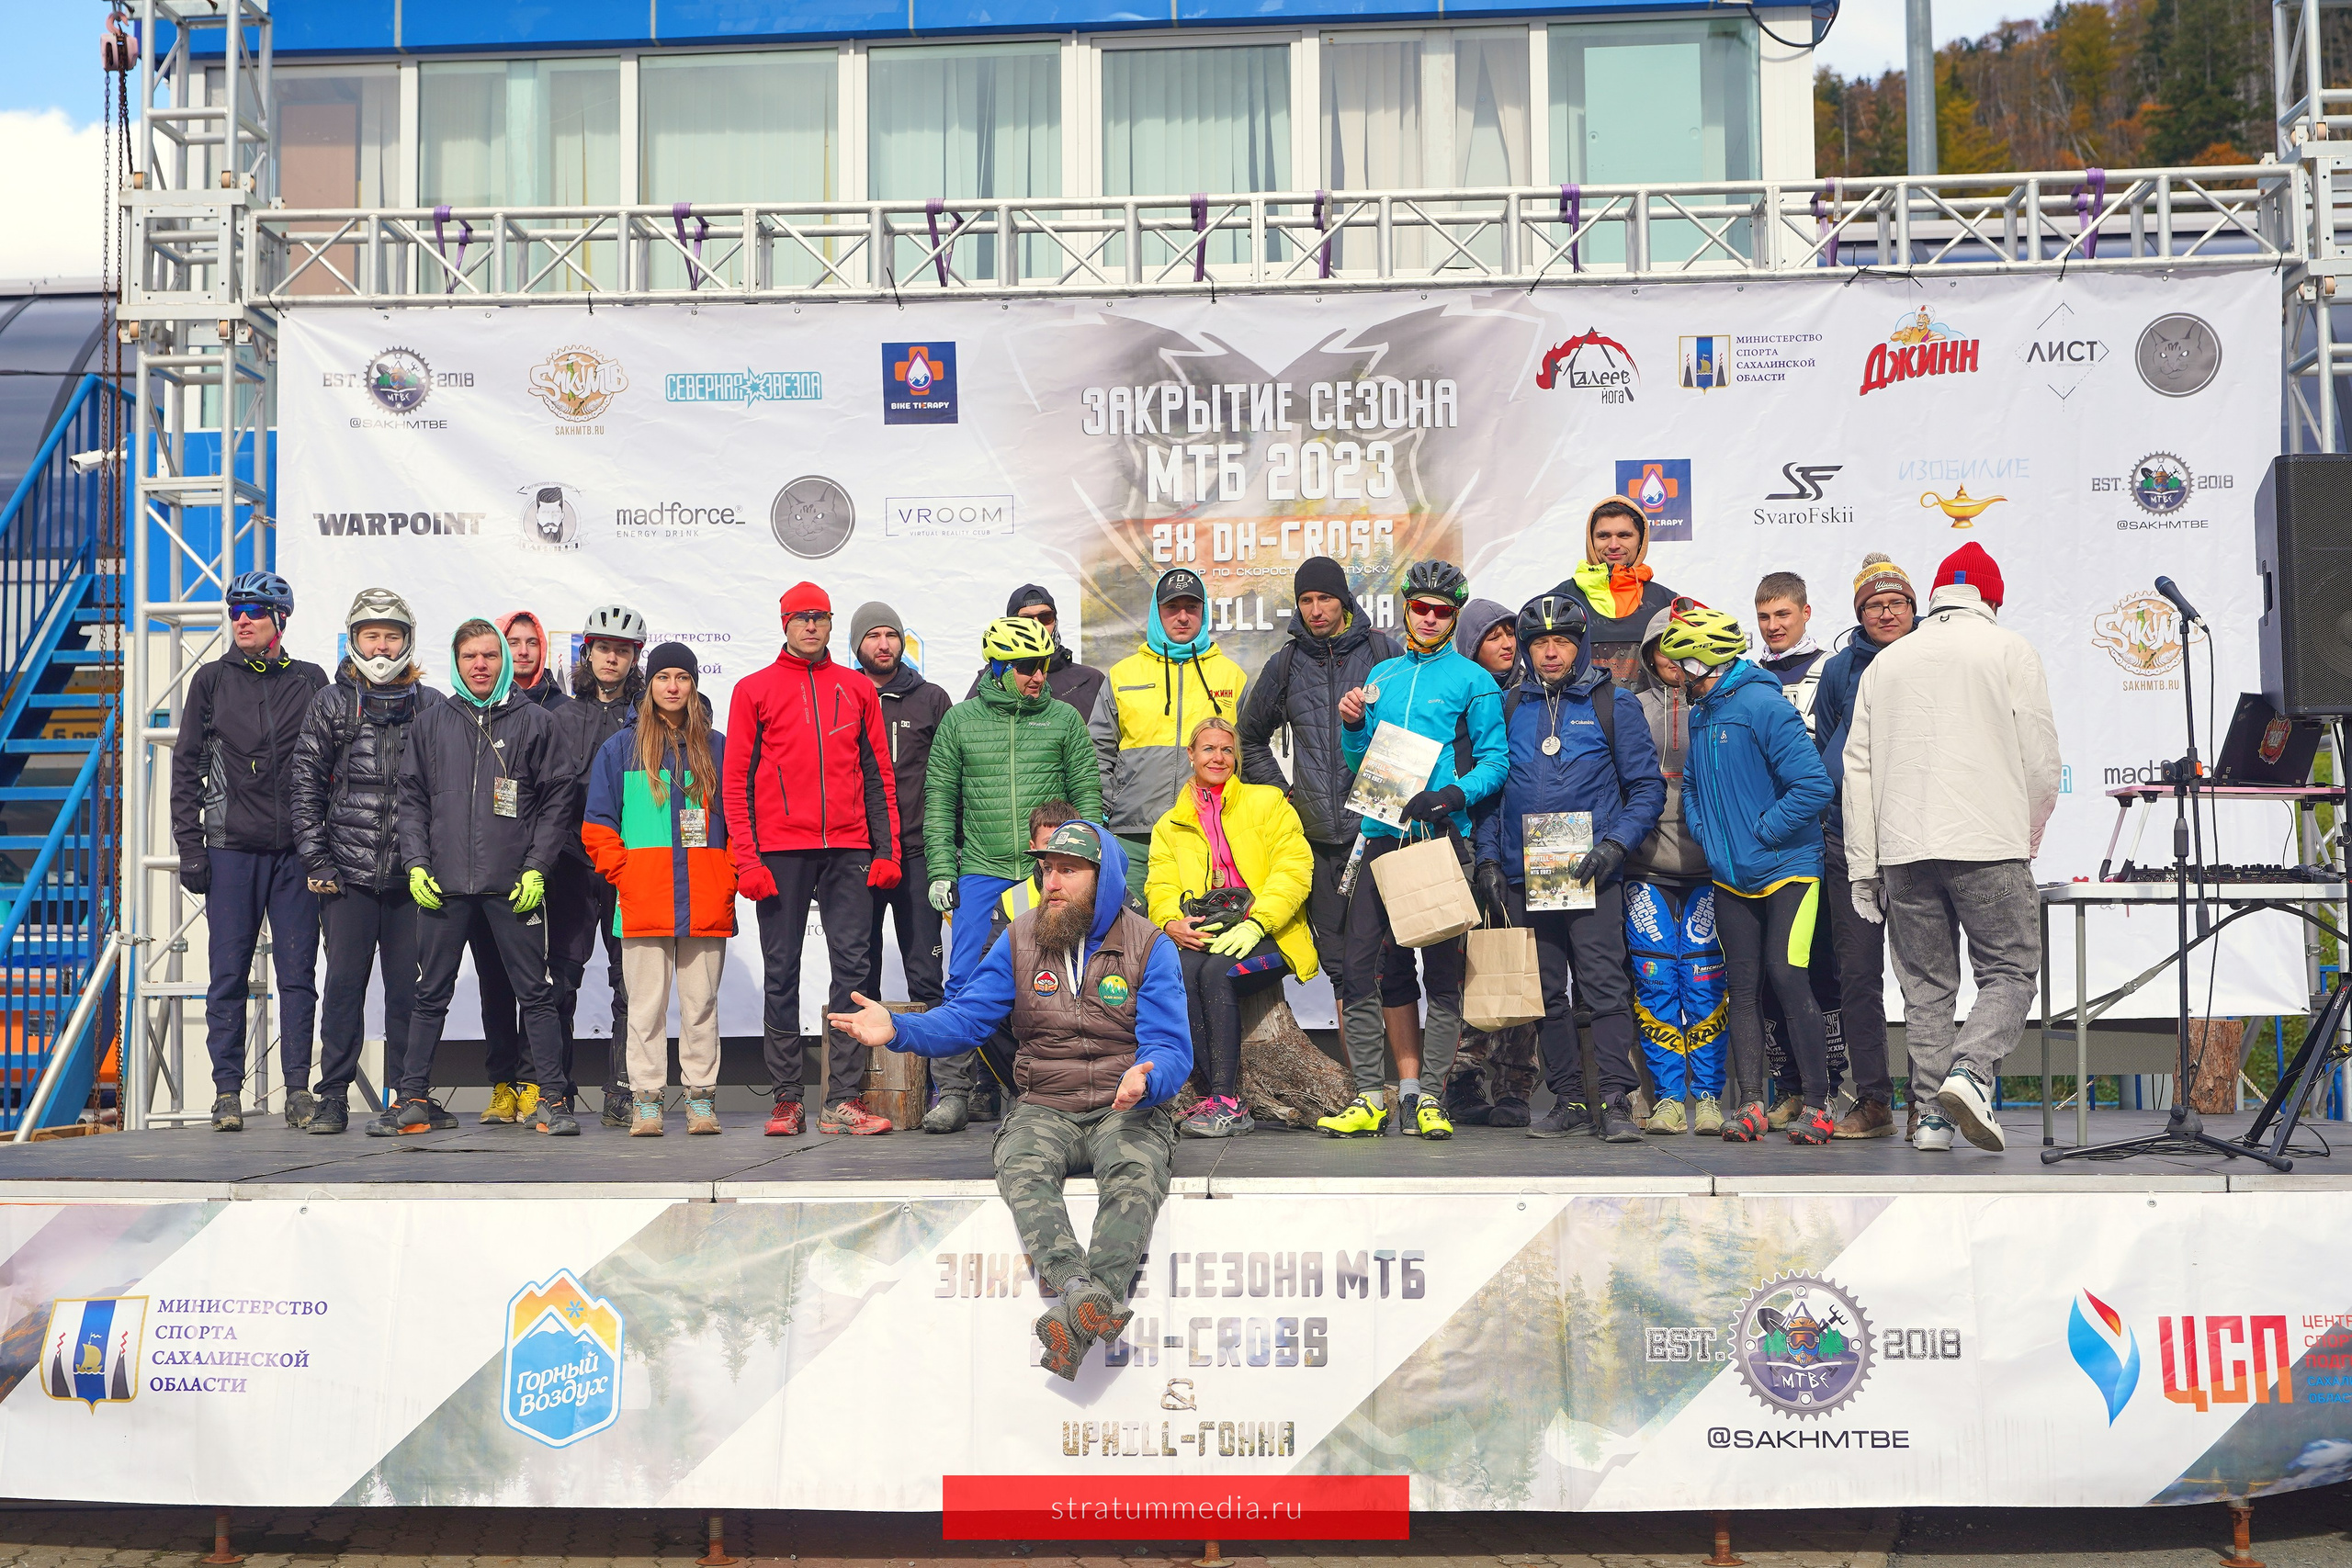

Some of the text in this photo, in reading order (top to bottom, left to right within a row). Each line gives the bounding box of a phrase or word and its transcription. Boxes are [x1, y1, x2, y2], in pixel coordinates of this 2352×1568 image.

[1736, 333, 1823, 344] МИНИСТЕРСТВО
[1736, 347, 1779, 356] СПОРТА
[2027, 340, 2098, 363] ЛИСТ
[1736, 357, 1815, 369] САХАЛИНСКОЙ
[322, 372, 475, 388] EST. 2018
[665, 371, 822, 401] СЕВЕРНАЯ ЗВЕЗДА
[1736, 373, 1785, 383] ОБЛАСТИ
[1601, 388, 1624, 404] йога
[1081, 378, 1458, 435] ЗАКРЫТИЕ СЕЗОНА
[349, 417, 447, 430] @SAKHMTBE
[555, 425, 605, 436] SAKHMTB.RU
[1147, 441, 1395, 503] МТБ 2023
[1898, 458, 2030, 481] ИЗОБИЛИЕ
[2091, 475, 2233, 492] EST. 2018
[313, 512, 486, 536] WARPOINT
[899, 507, 1002, 524] VROOM
[1753, 507, 1854, 525] SvaroFskii
[616, 529, 699, 538] ENERGY DRINK
[2116, 519, 2209, 531] @SAKHMTBE
[1213, 519, 1394, 561] DH-CROSS
[1168, 574, 1193, 585] FOX
[1213, 568, 1230, 577] ПО
[2122, 680, 2179, 691] SAKHMTB.RU
[1639, 889, 1658, 916] Chain
[1691, 897, 1708, 923] Chain
[1627, 885, 1663, 942] Reaction
[1827, 1044, 1844, 1053] XXIS
[934, 1250, 1426, 1300] ЗАКРЕ СЕЗОНА МТБ
[157, 1299, 328, 1315] МИНИСТЕРСТВО
[154, 1325, 237, 1341] СПОРТА
[1645, 1326, 1962, 1362] EST. 2018
[152, 1349, 310, 1368] САХАЛИНСКОЙ
[2157, 1315, 2293, 1413] ЦСП
[2305, 1354, 2352, 1370] ПОДГ
[516, 1351, 599, 1394] Горный
[1781, 1371, 1831, 1389] MTBE
[150, 1376, 247, 1393] ОБЛАСТИ
[518, 1375, 608, 1416] Воздух
[1160, 1378, 1197, 1411] &
[1707, 1427, 1910, 1449] @SAKHMTBE
